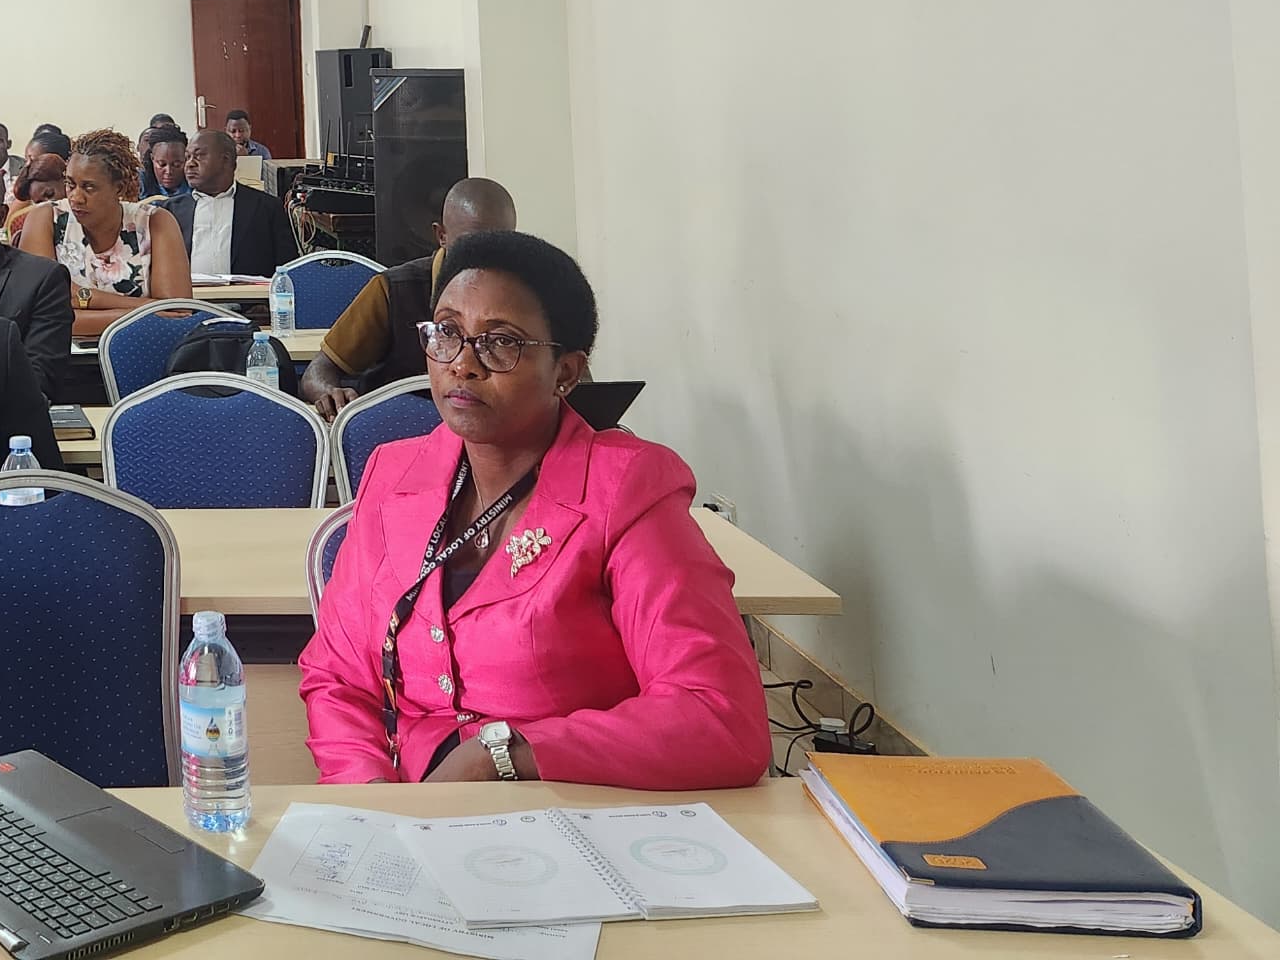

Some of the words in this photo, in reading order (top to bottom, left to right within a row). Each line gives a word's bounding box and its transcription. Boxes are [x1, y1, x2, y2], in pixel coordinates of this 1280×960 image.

[475, 494, 513, 531] MINISTRY
[463, 527, 476, 541] OF
[425, 544, 435, 558] OF
[435, 537, 464, 562] LOCAL
